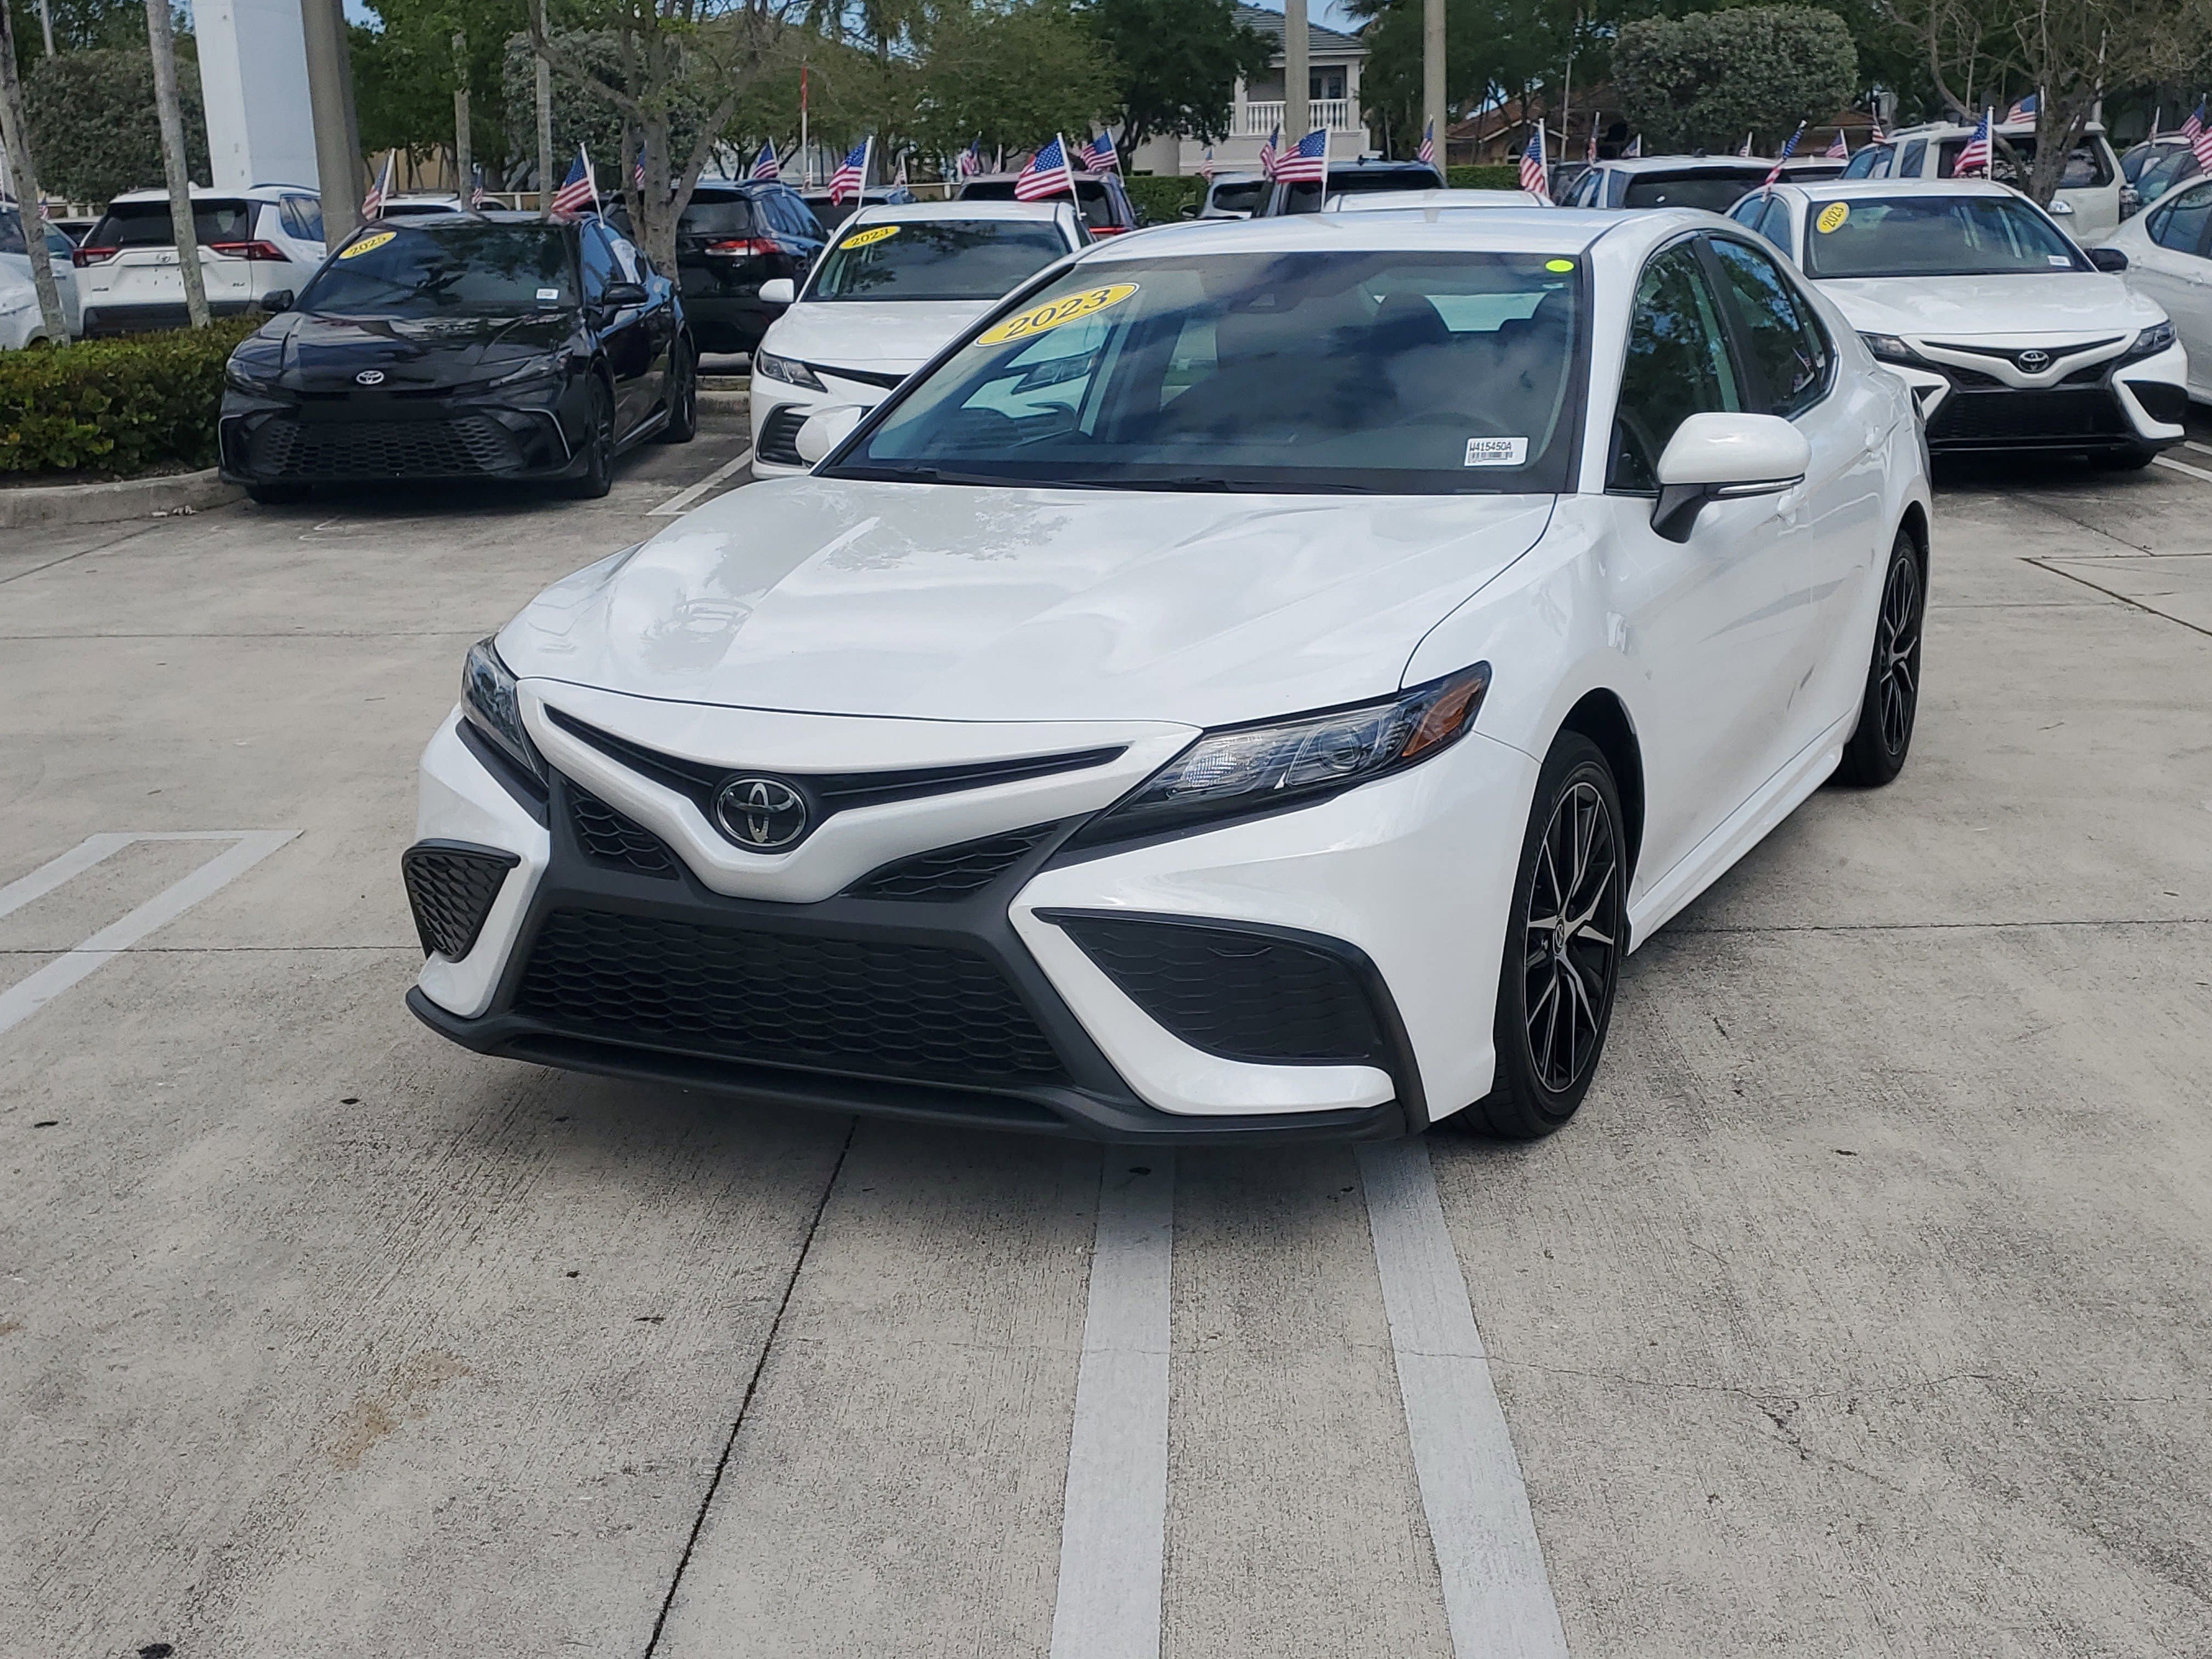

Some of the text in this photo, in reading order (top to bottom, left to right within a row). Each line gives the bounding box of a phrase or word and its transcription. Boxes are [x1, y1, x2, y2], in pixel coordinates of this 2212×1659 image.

[1822, 206, 1844, 228] 2023
[851, 228, 889, 246] 2023
[1003, 289, 1111, 339] 2023
